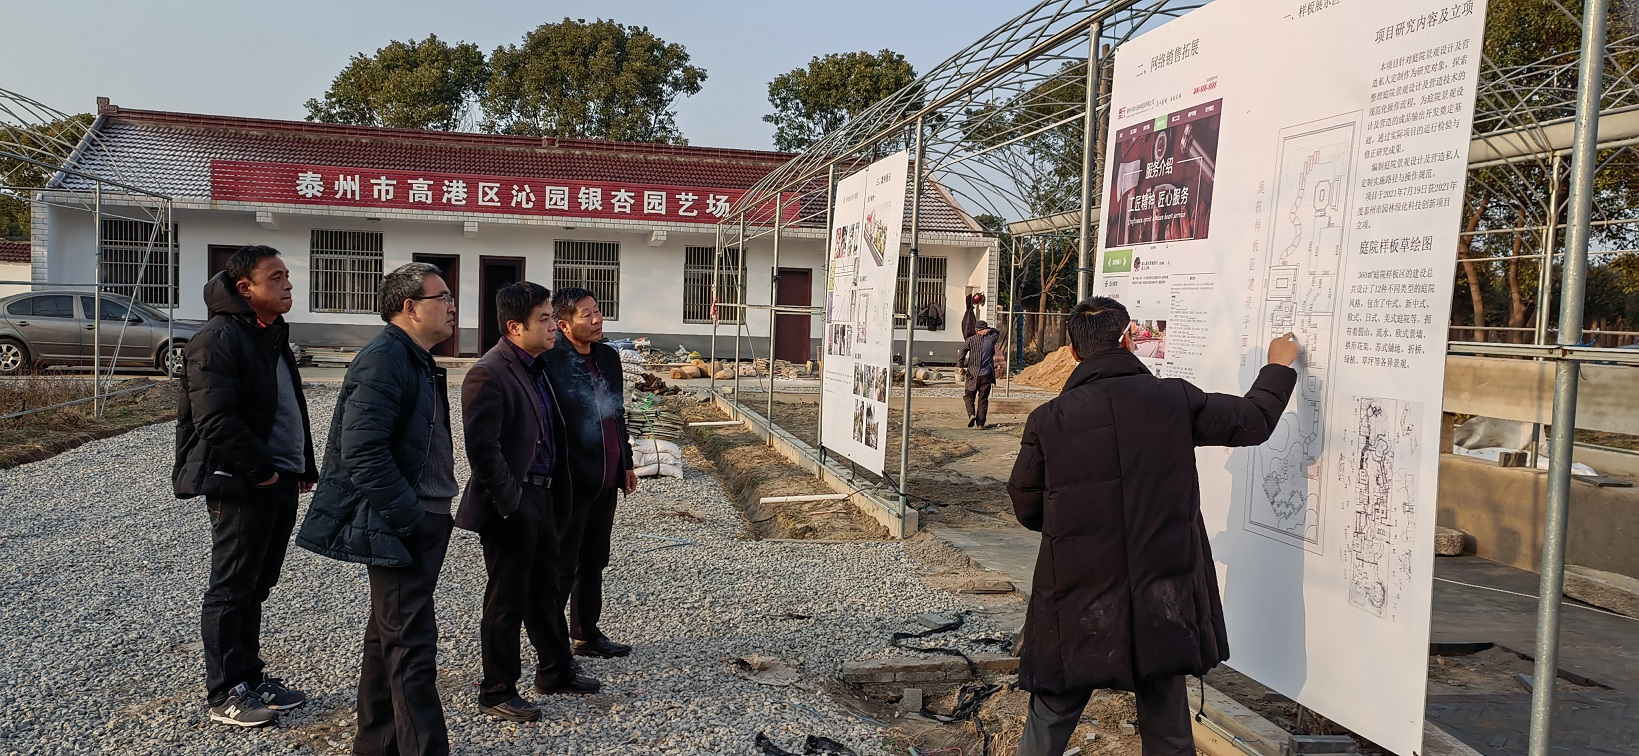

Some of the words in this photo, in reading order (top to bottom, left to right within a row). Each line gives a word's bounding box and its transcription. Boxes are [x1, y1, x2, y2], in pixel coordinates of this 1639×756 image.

[1375, 0, 1474, 44] 项目研究内容及立项
[1380, 38, 1470, 72] 本项目针对庭院景观设计及营
[1145, 157, 1174, 179] 服务介绍
[296, 172, 731, 218] 泰州市高港区沁园银杏园艺场
[1128, 191, 1156, 212] 工匠精神
[1158, 186, 1189, 208] 匠心服务
[1359, 236, 1433, 255] 庭院样板草绘图
[224, 705, 241, 719] N
